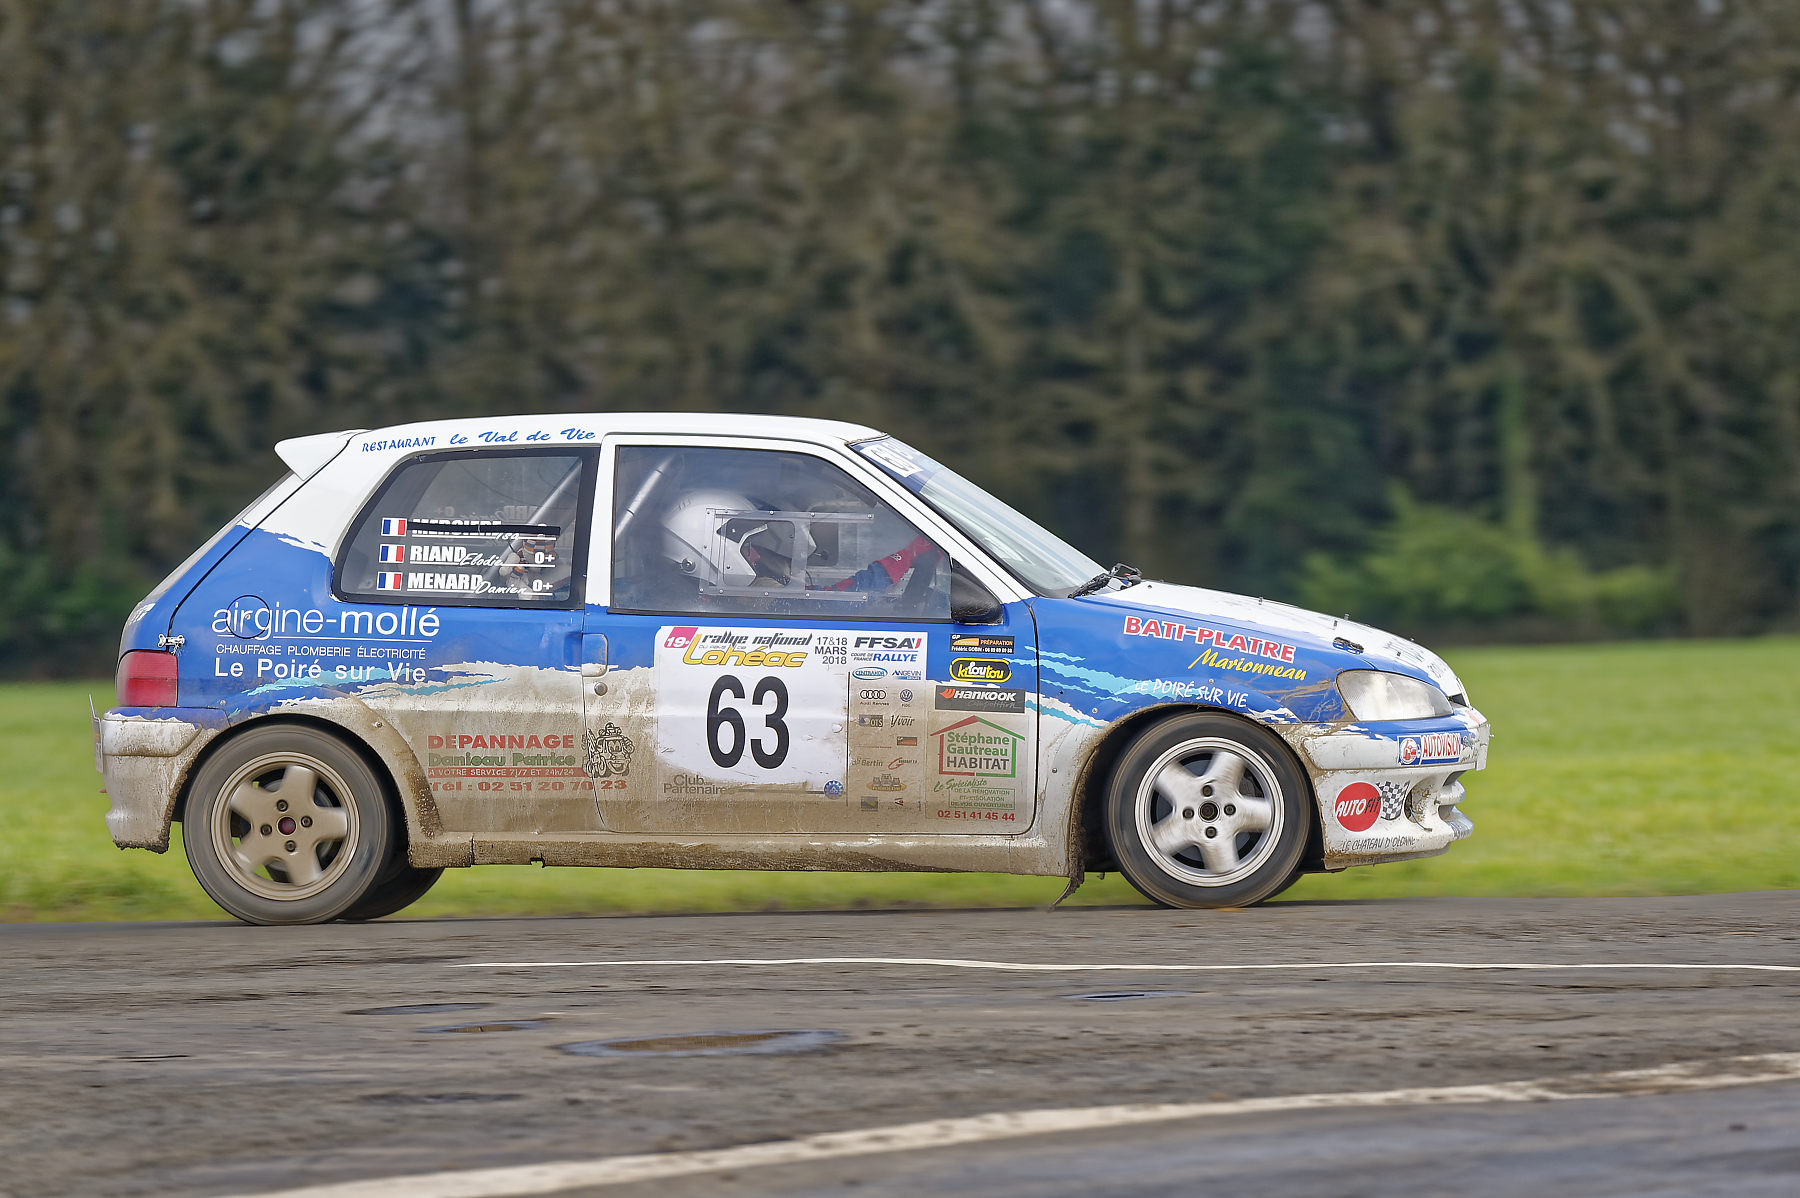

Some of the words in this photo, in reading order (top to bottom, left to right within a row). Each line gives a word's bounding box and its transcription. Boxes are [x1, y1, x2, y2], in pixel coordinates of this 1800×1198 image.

[362, 436, 437, 452] RESTAURANT
[450, 434, 468, 445] le
[478, 431, 519, 443] Val
[526, 430, 551, 442] de
[560, 428, 596, 441] Vie
[410, 545, 467, 562] RIAND
[460, 552, 504, 567] Elodie
[407, 572, 483, 590] MENARD
[474, 580, 527, 594] Damien
[211, 601, 440, 641] airgine-mollé
[702, 631, 748, 650] rallye
[752, 632, 813, 649] national
[817, 636, 848, 647] 17&18
[854, 637, 913, 649] FFSA
[1124, 616, 1297, 664] BATI-PLATRE
[216, 644, 282, 656] CHAUFFAGE
[287, 646, 351, 657] PLOMBERIE
[357, 645, 426, 660] ÉLECTRICITÉ
[683, 634, 808, 668] Lohéac
[814, 645, 848, 656] MARS
[873, 653, 918, 662] RALLYE
[822, 655, 848, 666] 2018
[1188, 648, 1307, 681] Marionneau
[215, 658, 244, 677] Le
[257, 658, 322, 680] Poiré
[335, 664, 376, 681] sur
[388, 661, 426, 682] Vie
[1135, 680, 1148, 692] LE
[1152, 678, 1195, 698] POIRÉ
[1196, 686, 1223, 704] SUR
[1227, 692, 1249, 708] VIE
[706, 674, 790, 769] 63
[427, 734, 575, 750] DEPANNAGE
[947, 731, 1010, 746] Stéphane
[1422, 733, 1461, 758] AUTOVISION
[946, 743, 1008, 757] Gautreau
[428, 751, 507, 767] Danieau
[512, 752, 577, 767] Patrice
[946, 756, 1010, 771] HABITAT
[438, 768, 467, 776] VOTRE
[470, 768, 508, 776] SERVICE
[530, 768, 541, 776] ET
[673, 774, 704, 786] Club
[477, 781, 504, 792] 02
[510, 781, 532, 792] 51
[537, 781, 564, 792] 20
[570, 781, 594, 792] 70
[600, 779, 627, 790] 23
[937, 810, 950, 818] 02
[954, 810, 967, 819] 51
[969, 811, 982, 820] 41
[985, 811, 998, 820] 45
[1001, 812, 1015, 821] 44
[1341, 840, 1351, 852] LE
[1352, 837, 1385, 851] CHATEAU
